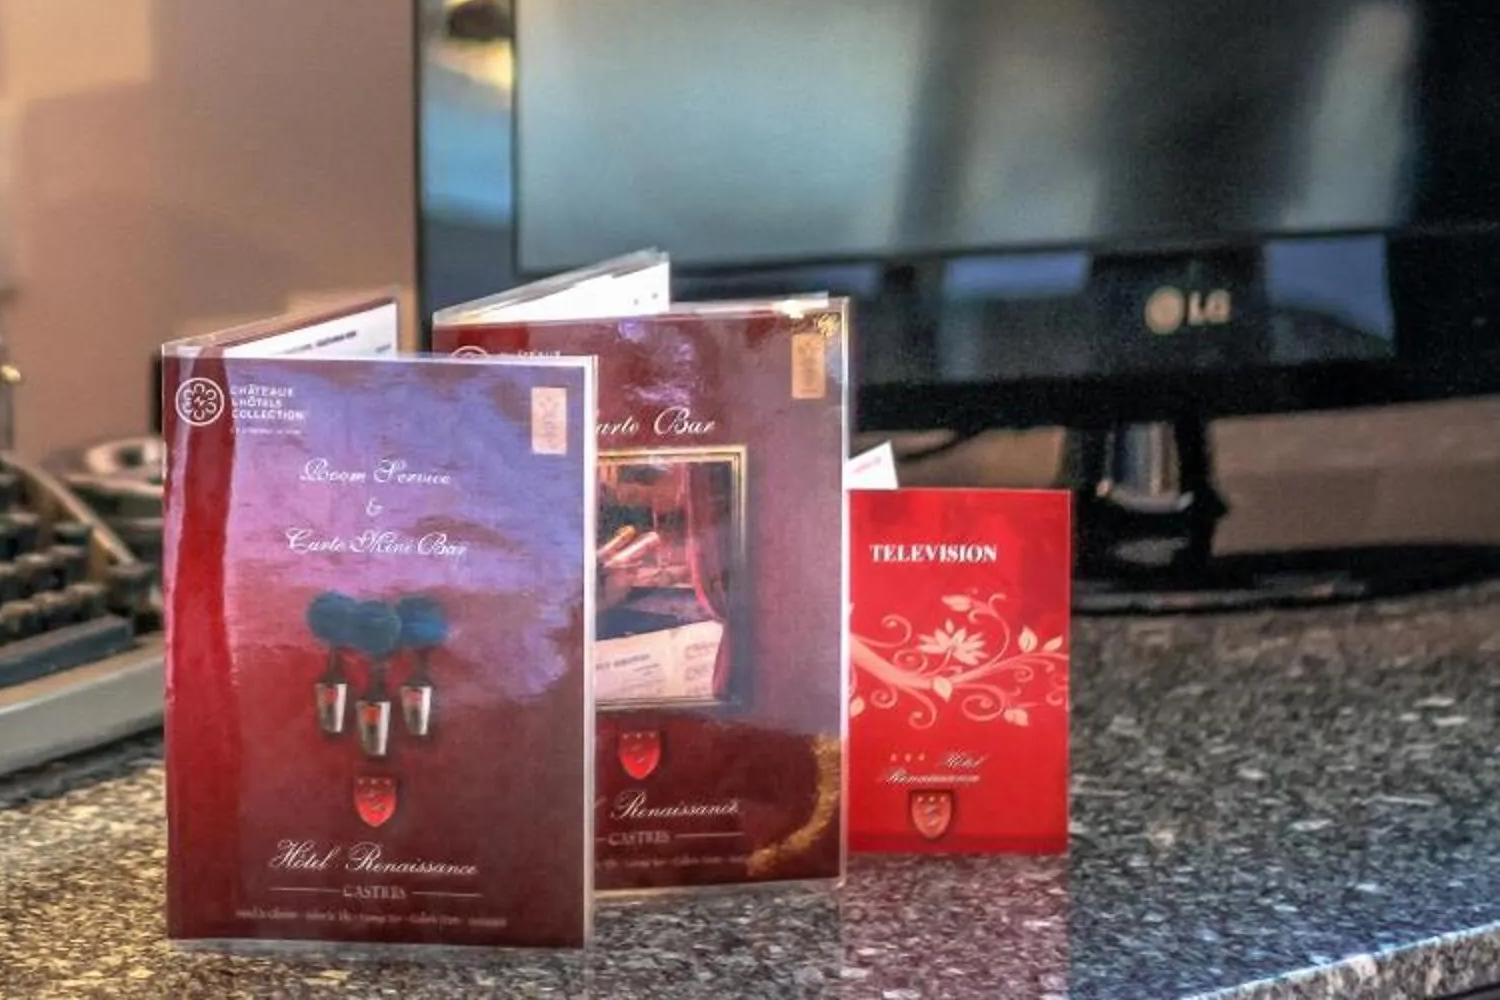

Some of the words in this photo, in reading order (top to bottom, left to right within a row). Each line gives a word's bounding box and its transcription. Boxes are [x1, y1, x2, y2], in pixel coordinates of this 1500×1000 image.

[1187, 289, 1231, 326] LG
[232, 409, 305, 421] COLLECTION
[596, 415, 640, 437] arte
[653, 406, 716, 437] Bar
[300, 457, 367, 484] Room
[372, 459, 453, 486] Service
[285, 526, 346, 555] Carte
[417, 531, 469, 561] Bar
[870, 543, 998, 564] TELEVISION
[610, 790, 742, 820] Renaissance
[269, 838, 339, 871] Hôtel
[345, 840, 478, 876] Renaissance
